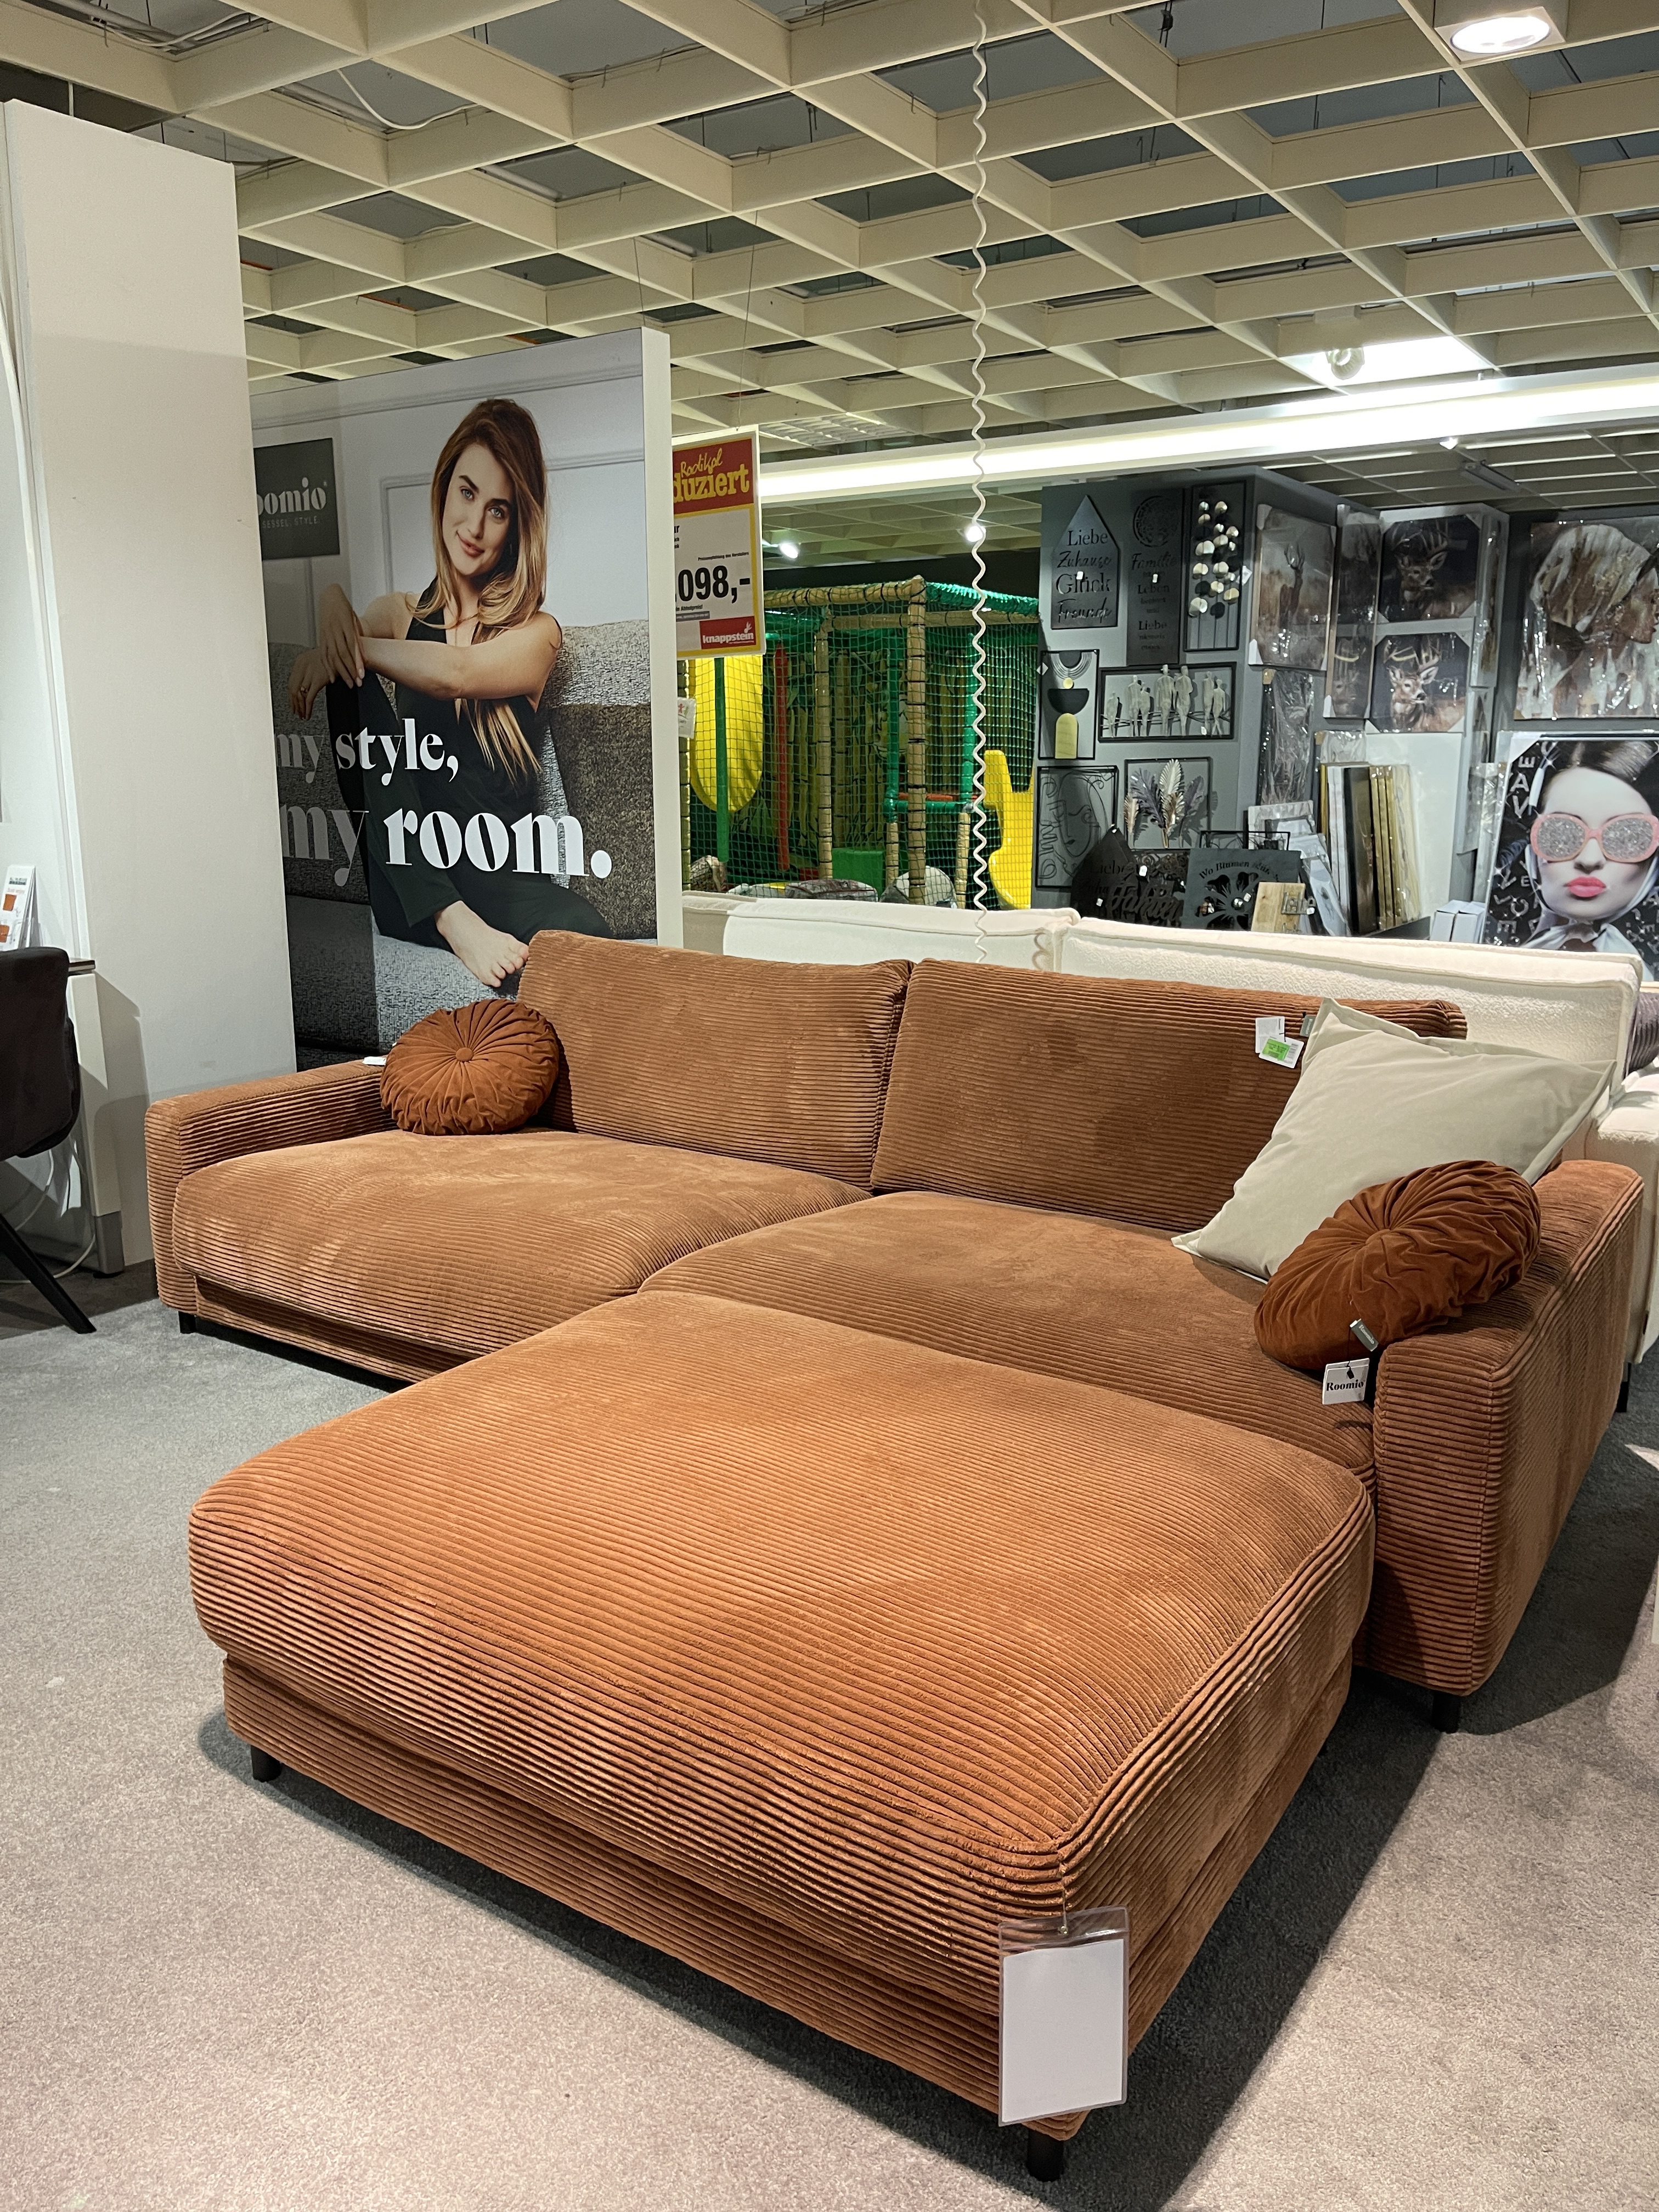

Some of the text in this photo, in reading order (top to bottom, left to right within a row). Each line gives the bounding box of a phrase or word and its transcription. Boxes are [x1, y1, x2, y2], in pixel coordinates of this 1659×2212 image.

[680, 448, 723, 478] Radikal
[1067, 529, 1108, 546] Liebe
[1057, 550, 1112, 568] Zuhause
[1131, 551, 1177, 571] Familie
[675, 565, 750, 603] 098,-
[1056, 572, 1111, 595] Glück
[1058, 597, 1113, 624] Freunde
[1139, 619, 1167, 630] Liebe
[702, 632, 754, 644] knappstein
[335, 718, 459, 786] style,
[280, 804, 612, 887] my room.
[1326, 1379, 1364, 1391] Roomio
